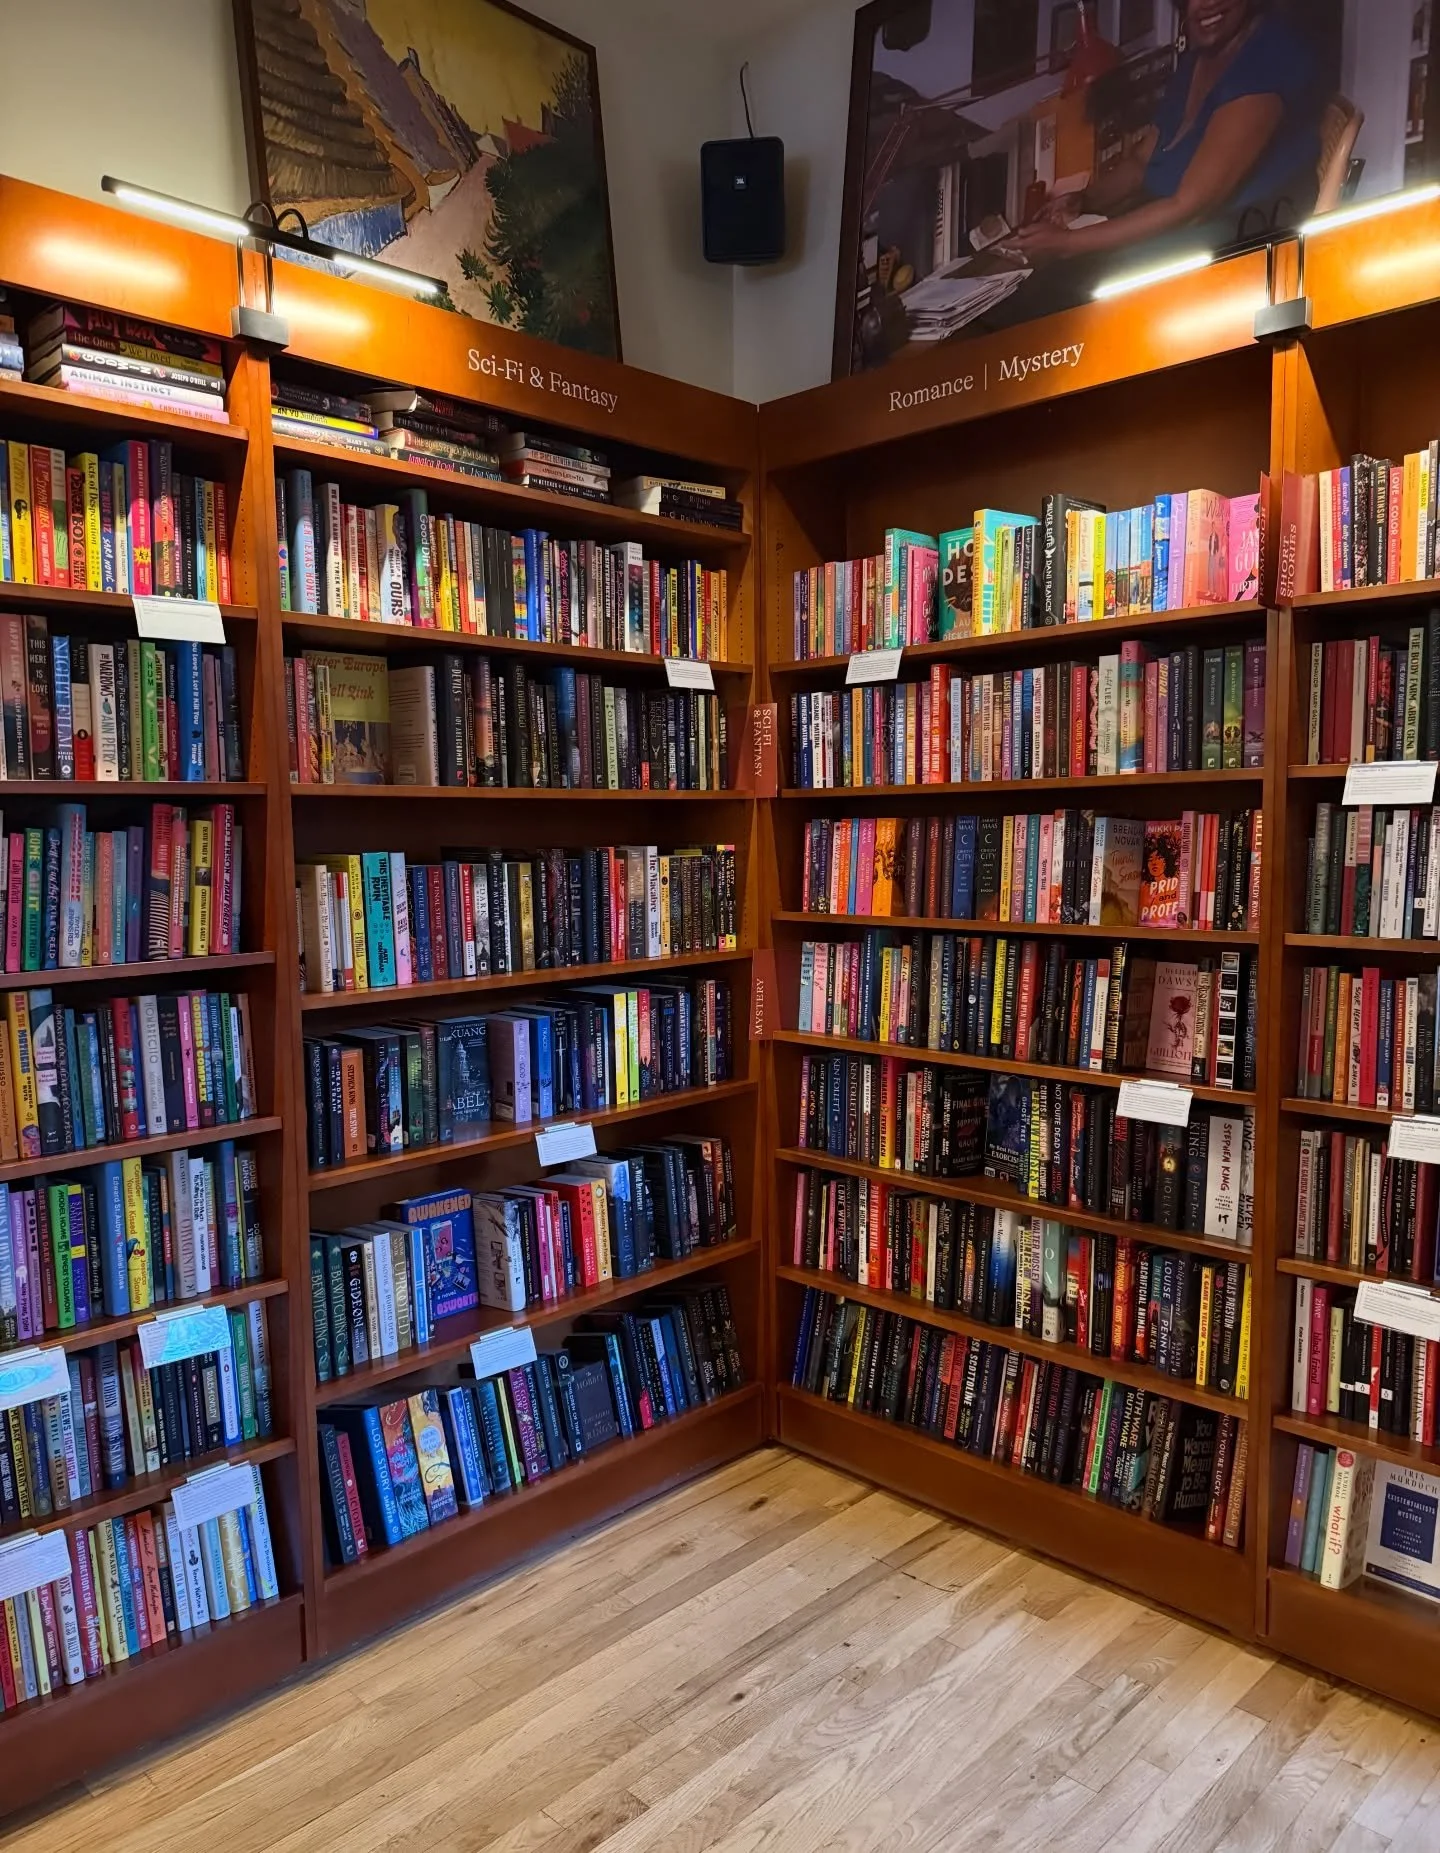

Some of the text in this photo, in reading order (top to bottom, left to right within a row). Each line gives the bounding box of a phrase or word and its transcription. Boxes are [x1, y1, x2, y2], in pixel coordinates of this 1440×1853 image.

[70, 369, 172, 397] ANIMAL INSTINCT
[468, 348, 618, 413] Sci-Fi & Fantasy
[889, 342, 1084, 412] Romance Mystery
[87, 460, 98, 546] Acts Desperation
[206, 491, 214, 515] WHALE
[1341, 481, 1351, 516] dear dolly
[1376, 466, 1386, 525] KATE ATKINSON
[1390, 472, 1401, 536] LOVE COLOR
[102, 537, 114, 560] SARA
[419, 513, 431, 567] Good Dirt
[947, 537, 976, 562] HO
[1259, 507, 1267, 596] ROMANCE
[1287, 523, 1298, 598] STORIES
[1341, 524, 1351, 569] dolly alderton
[304, 539, 315, 603] TEXAS HONEY
[603, 548, 611, 618] MISINTERPRETATION
[1280, 535, 1290, 597] SHORT
[389, 581, 403, 617] OURS
[1044, 579, 1052, 612] FRANCIS
[30, 639, 47, 650] THIS
[30, 654, 48, 664] HERE
[342, 657, 387, 677] Europe
[1411, 652, 1420, 675] BODY
[31, 684, 49, 694] LOVE
[53, 639, 72, 749] NIGHT FILM
[115, 648, 127, 717] The Berry Pickers
[192, 654, 201, 726] Love You
[349, 686, 380, 701] Zink
[451, 668, 462, 695] DEVILS
[1158, 663, 1168, 698] SPIRAL
[1409, 677, 1418, 701] FARM
[100, 659, 116, 765] NARROWS ANN PETRY
[762, 708, 772, 747] SCI-FI
[896, 699, 905, 743] BEACH READ
[1407, 705, 1417, 726] ABBY
[15, 714, 24, 764] PERKINS-VALDEZ
[753, 709, 762, 777] & FANTASY
[1408, 832, 1418, 866] MURAKAMI
[371, 876, 382, 902] RUIN
[378, 856, 391, 921] THIS INEVITABLE
[650, 871, 658, 913] Macabre
[1026, 877, 1034, 910] PAIRING
[1149, 877, 1179, 892] PRID
[1251, 866, 1261, 918] KENNEDY RYAN
[1312, 873, 1324, 922] Lydia Millet
[49, 936, 57, 959] REID
[754, 978, 764, 1035] MYSTERY
[1352, 986, 1362, 1032] SOUR HEART
[16, 1013, 30, 1074] THE MOTHERS
[145, 1002, 158, 1065] HOMBRECITO
[451, 1026, 486, 1039] KUANG
[1105, 1018, 1118, 1060] ERUPTION
[1243, 1025, 1254, 1078] DAVID ELLIS
[849, 1061, 860, 1119] KEN FOLLETT
[1021, 1096, 1029, 1119] GHOST
[63, 1121, 72, 1144] PEACE
[1053, 1127, 1062, 1148] DEAD
[242, 1159, 250, 1192] MUNGO
[248, 1159, 258, 1190] YOUNG
[1219, 1122, 1233, 1191] STEPHEN KING
[112, 1176, 120, 1200] Edward
[134, 1164, 142, 1197] Consider
[1162, 1177, 1173, 1217] HOLLY
[57, 1190, 67, 1240] MODEL HOME
[114, 1214, 122, 1238] Aubyn
[859, 1210, 867, 1229] HOME
[869, 1184, 880, 1250] PONY CONFIDENTIAL
[1297, 1170, 1310, 1240] GARDEN AGAINST TIME
[584, 1238, 592, 1276] ROBINSON
[311, 1274, 329, 1349] BEWITCHING
[331, 1269, 348, 1344] BEWITCHING
[349, 1278, 365, 1331] GIDEON
[394, 1260, 409, 1335] UPROOTED
[1159, 1259, 1173, 1355] LOUISE PENNY
[1225, 1262, 1240, 1329] DOUGLAS PRESTON
[961, 1352, 979, 1405] SCOTTOLINE
[1310, 1331, 1322, 1385] black friend
[370, 1427, 385, 1453] LOST
[526, 1426, 538, 1459] ANDREA
[1119, 1391, 1135, 1449] RUTH WARE
[64, 1431, 76, 1480] FIGHT NIGHT
[107, 1419, 123, 1471] LONG ISLAND
[520, 1426, 532, 1462] STEWART
[376, 1456, 393, 1492] STORY
[1390, 1472, 1438, 1495] MURDOCH
[1404, 1468, 1425, 1482] IRIS
[254, 1496, 265, 1526] Weiner
[348, 1486, 364, 1538] VICIOUS
[1230, 1478, 1248, 1528] WINSPEAR
[1387, 1491, 1435, 1515] EXISTENTIALISTS
[1397, 1509, 1422, 1524] MYSTICS
[1328, 1504, 1346, 1556] what if?
[75, 1540, 88, 1591] SATISFACTION
[115, 1523, 130, 1587] SALVAGE BONES
[104, 1520, 126, 1645] JESMYN WARD Descend
